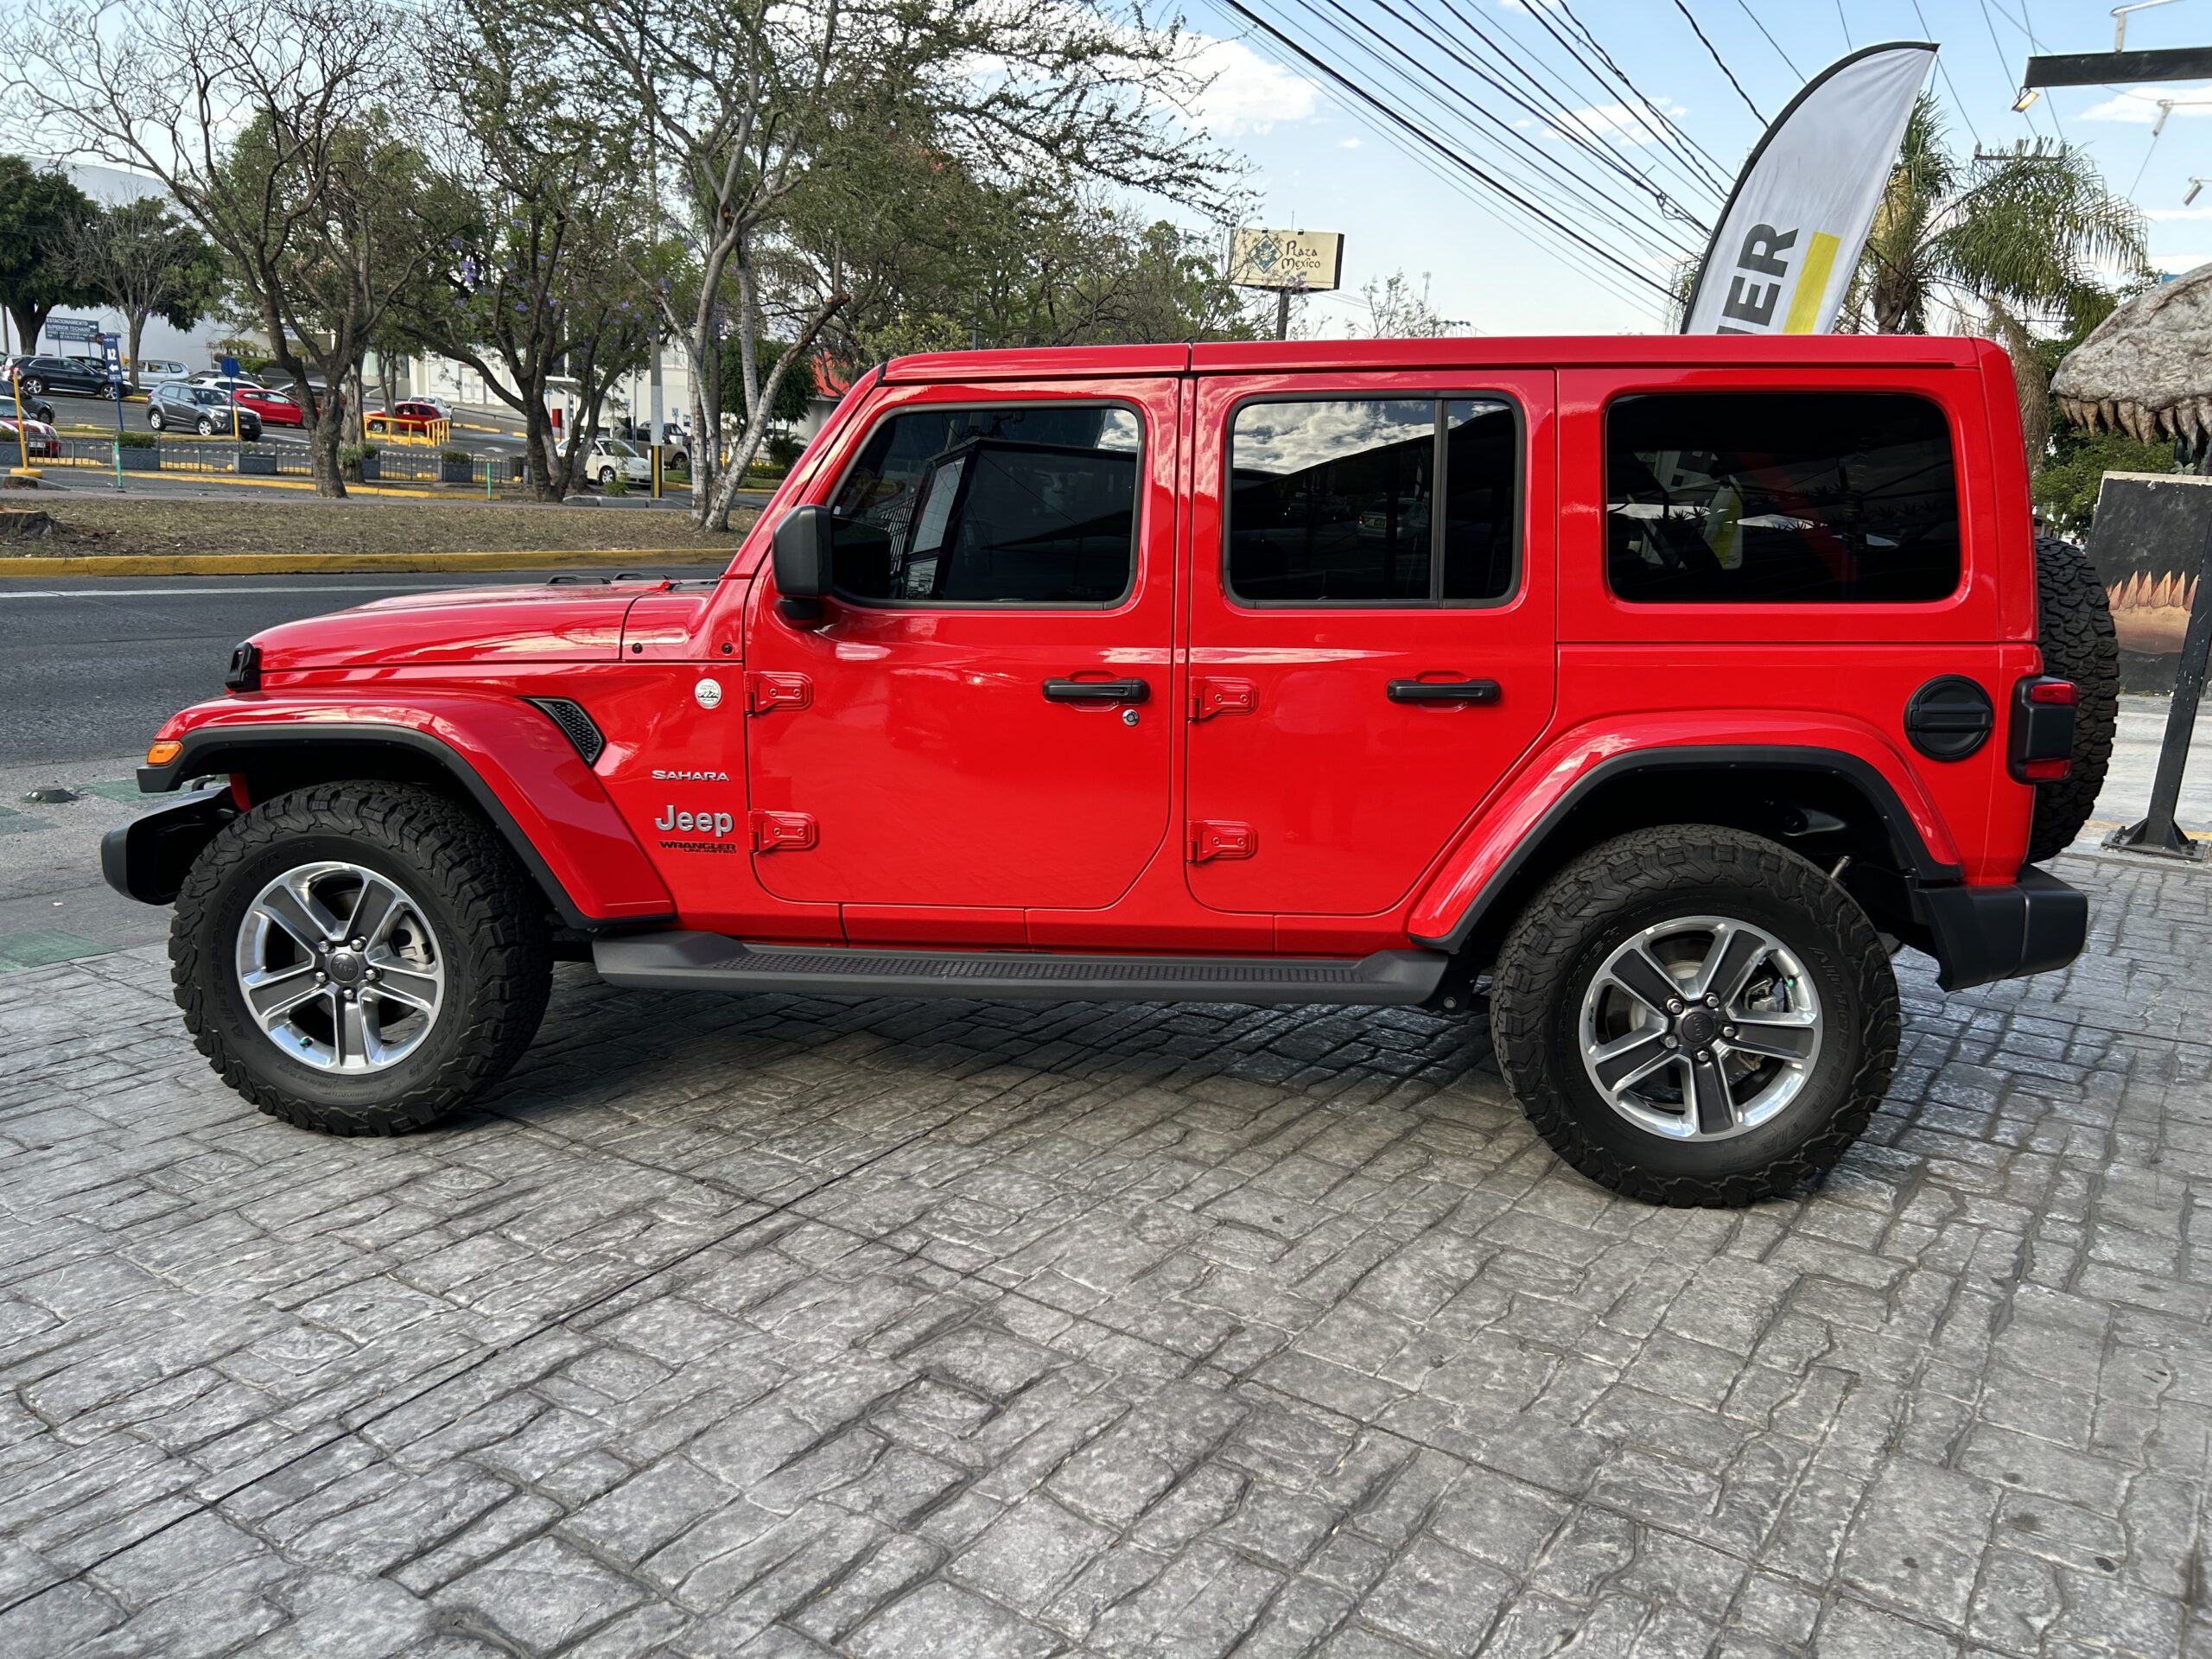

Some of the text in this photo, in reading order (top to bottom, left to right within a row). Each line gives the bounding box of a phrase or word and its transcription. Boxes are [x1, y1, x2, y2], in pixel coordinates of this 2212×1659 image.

[1715, 223, 1799, 334] ER
[652, 770, 730, 781] SAHARA
[655, 804, 734, 837] Jeep
[658, 841, 737, 851] WRANGLER
